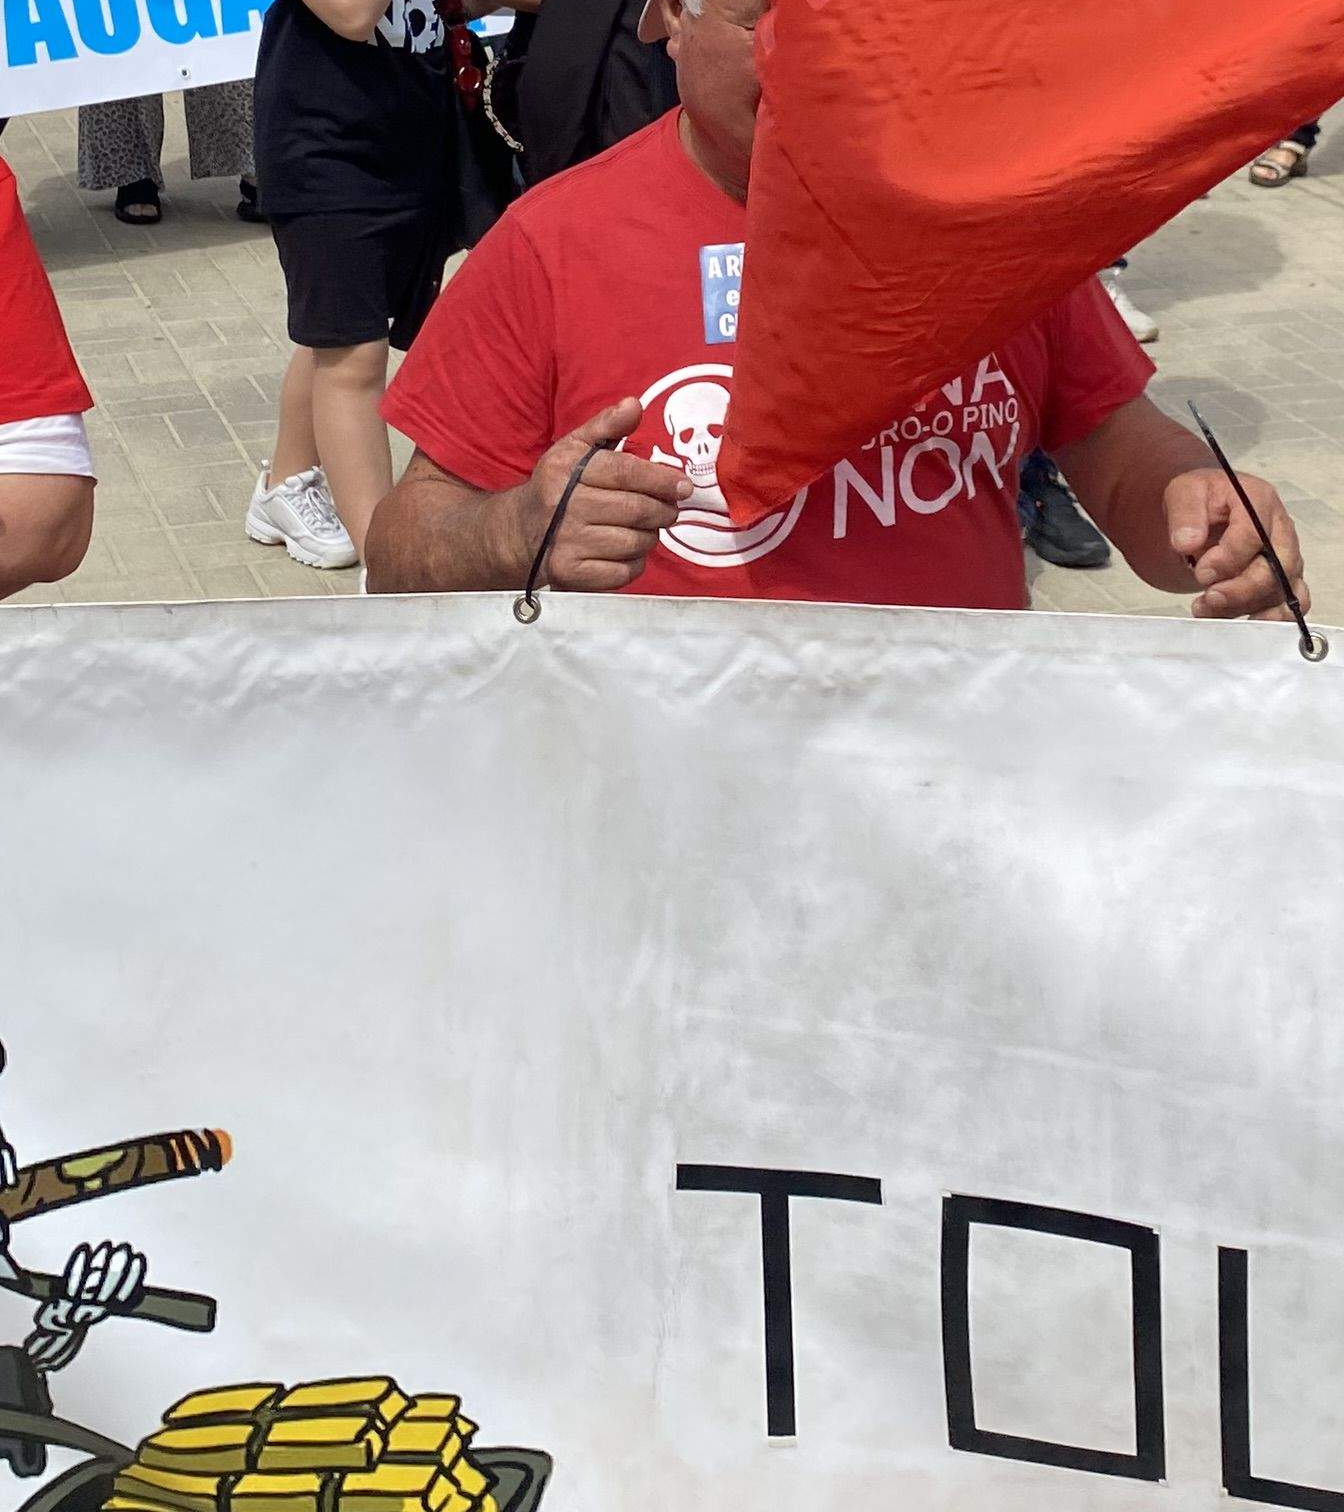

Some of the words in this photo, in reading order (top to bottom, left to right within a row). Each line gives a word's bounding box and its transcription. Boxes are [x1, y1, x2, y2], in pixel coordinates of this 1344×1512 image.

[707, 255, 723, 280] A
[962, 397, 1019, 433] PINO
[832, 421, 1020, 539] NON
